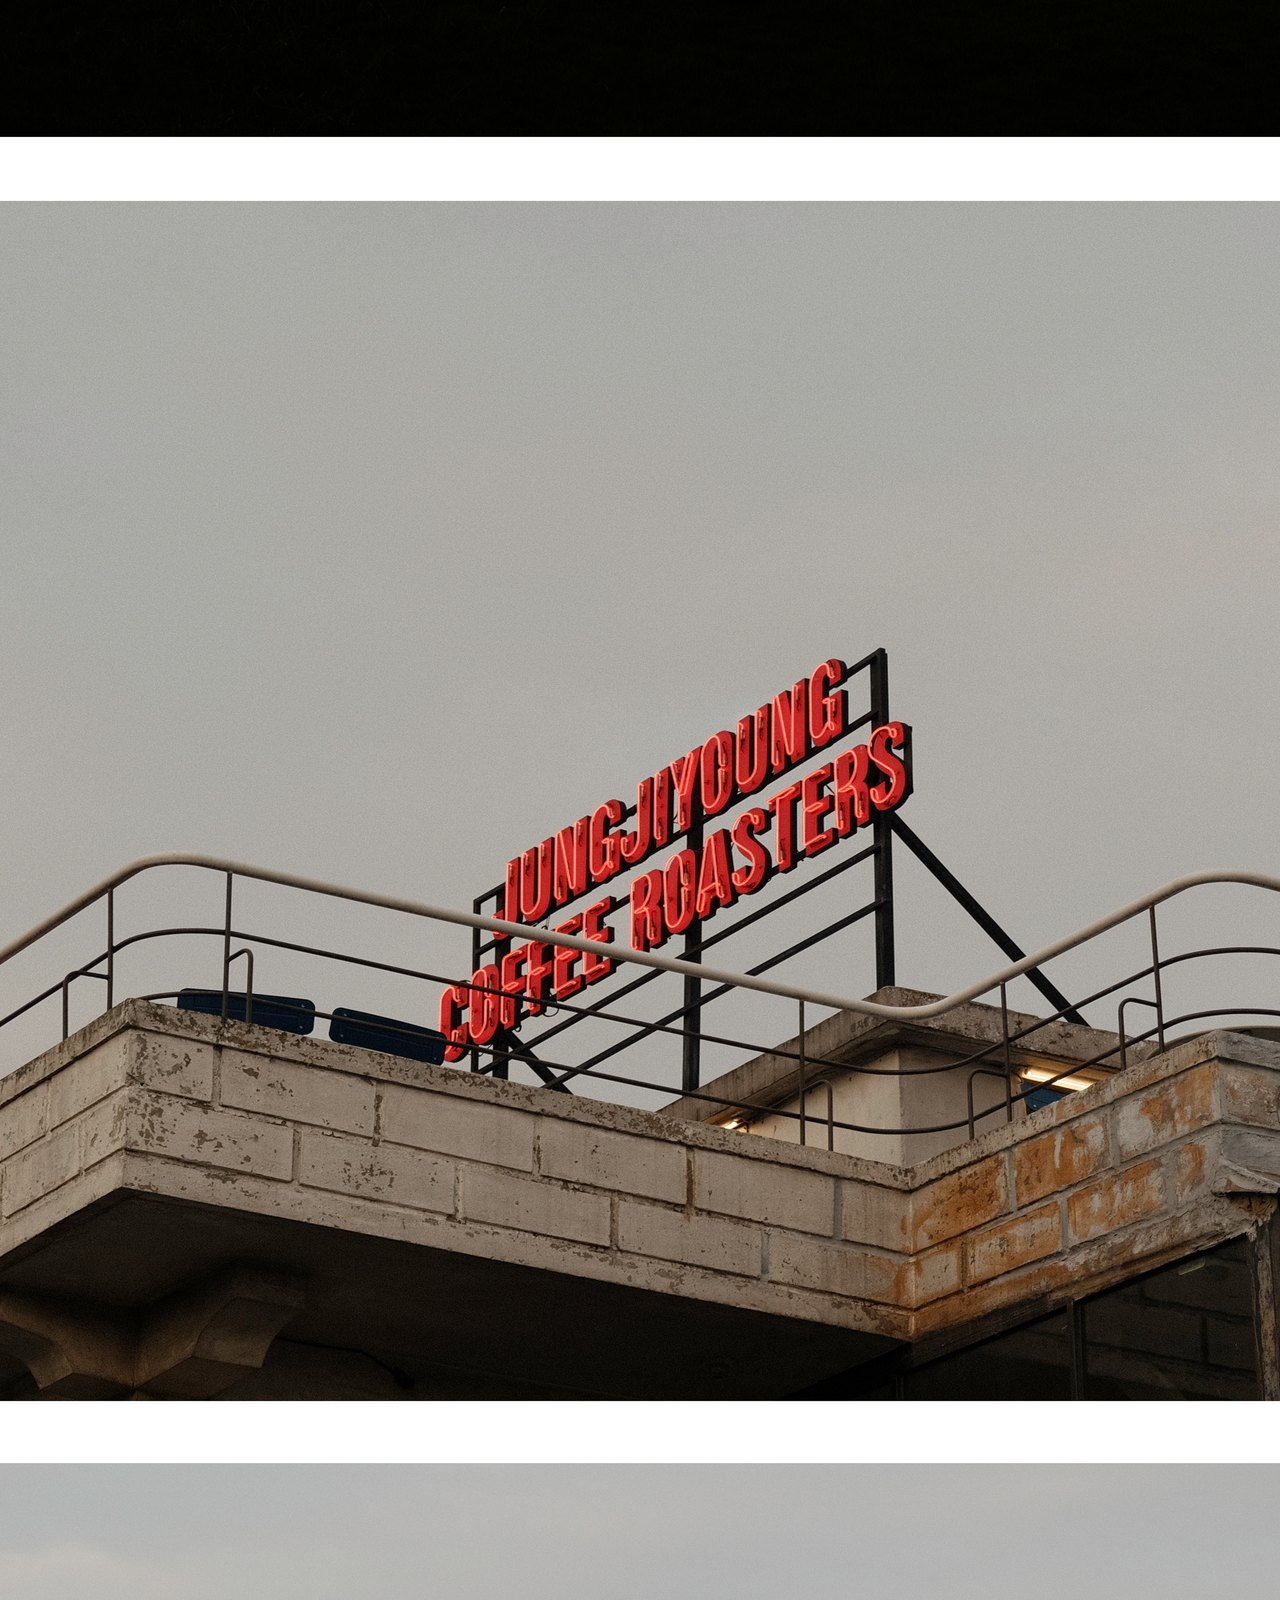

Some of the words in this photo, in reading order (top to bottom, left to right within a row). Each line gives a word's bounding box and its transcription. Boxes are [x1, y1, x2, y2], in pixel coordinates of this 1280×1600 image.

[438, 895, 617, 1063] COFFEE
[630, 720, 913, 952] ROASTERS
[493, 658, 849, 940] JUNGJIYOUNG
